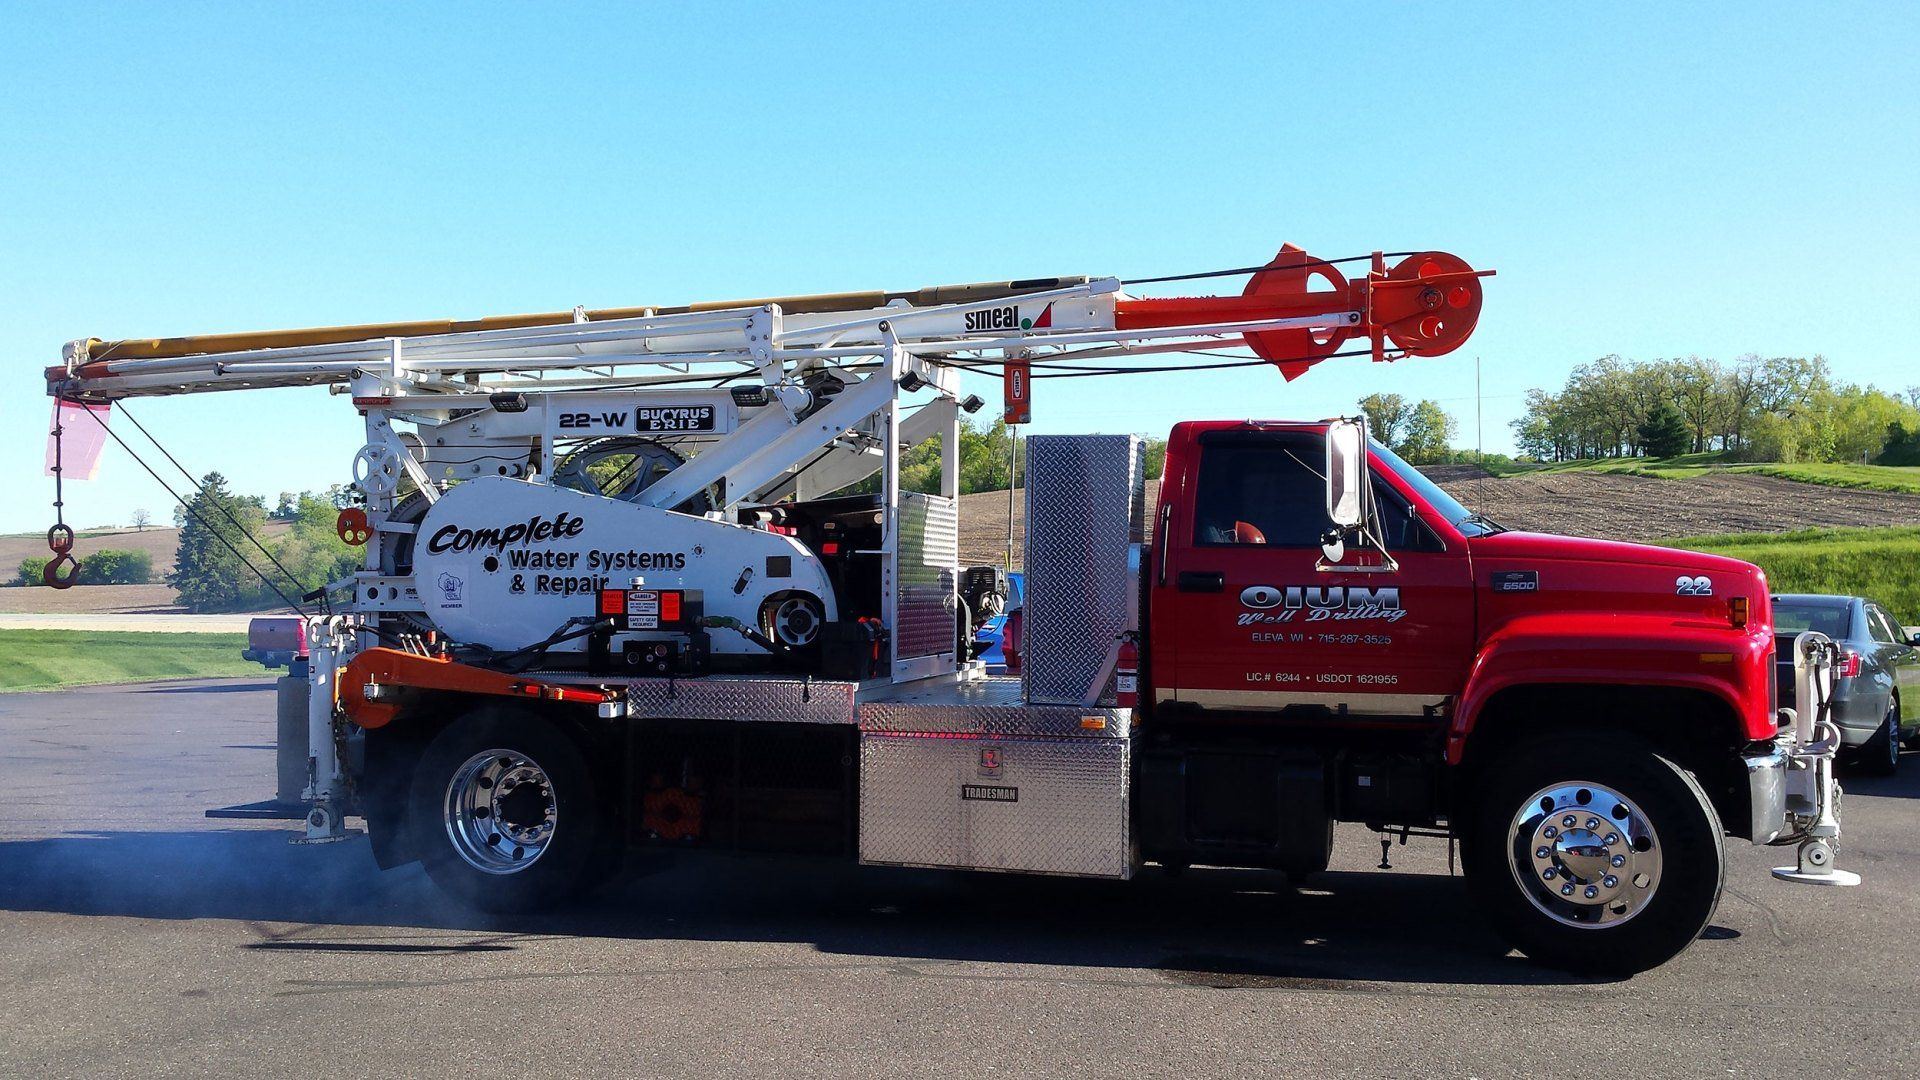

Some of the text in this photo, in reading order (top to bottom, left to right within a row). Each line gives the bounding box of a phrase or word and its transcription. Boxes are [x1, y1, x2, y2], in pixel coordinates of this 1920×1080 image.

[965, 305, 1019, 330] smeal
[559, 412, 628, 428] 22-W
[640, 408, 710, 423] BUCYRUS
[650, 419, 700, 430] ERIE
[428, 512, 584, 554] Complete
[509, 549, 686, 573] Water Systems
[510, 574, 610, 599] & Repair
[1676, 575, 1713, 596] 22
[1240, 586, 1400, 610] OIUM
[1237, 604, 1408, 625] Well Drilling
[1252, 632, 1392, 645] ELEVA WI 715-287-3525
[1246, 672, 1398, 684] LIC.# 6244 USDOT 1621955
[965, 787, 1016, 800] TRADESMAN
